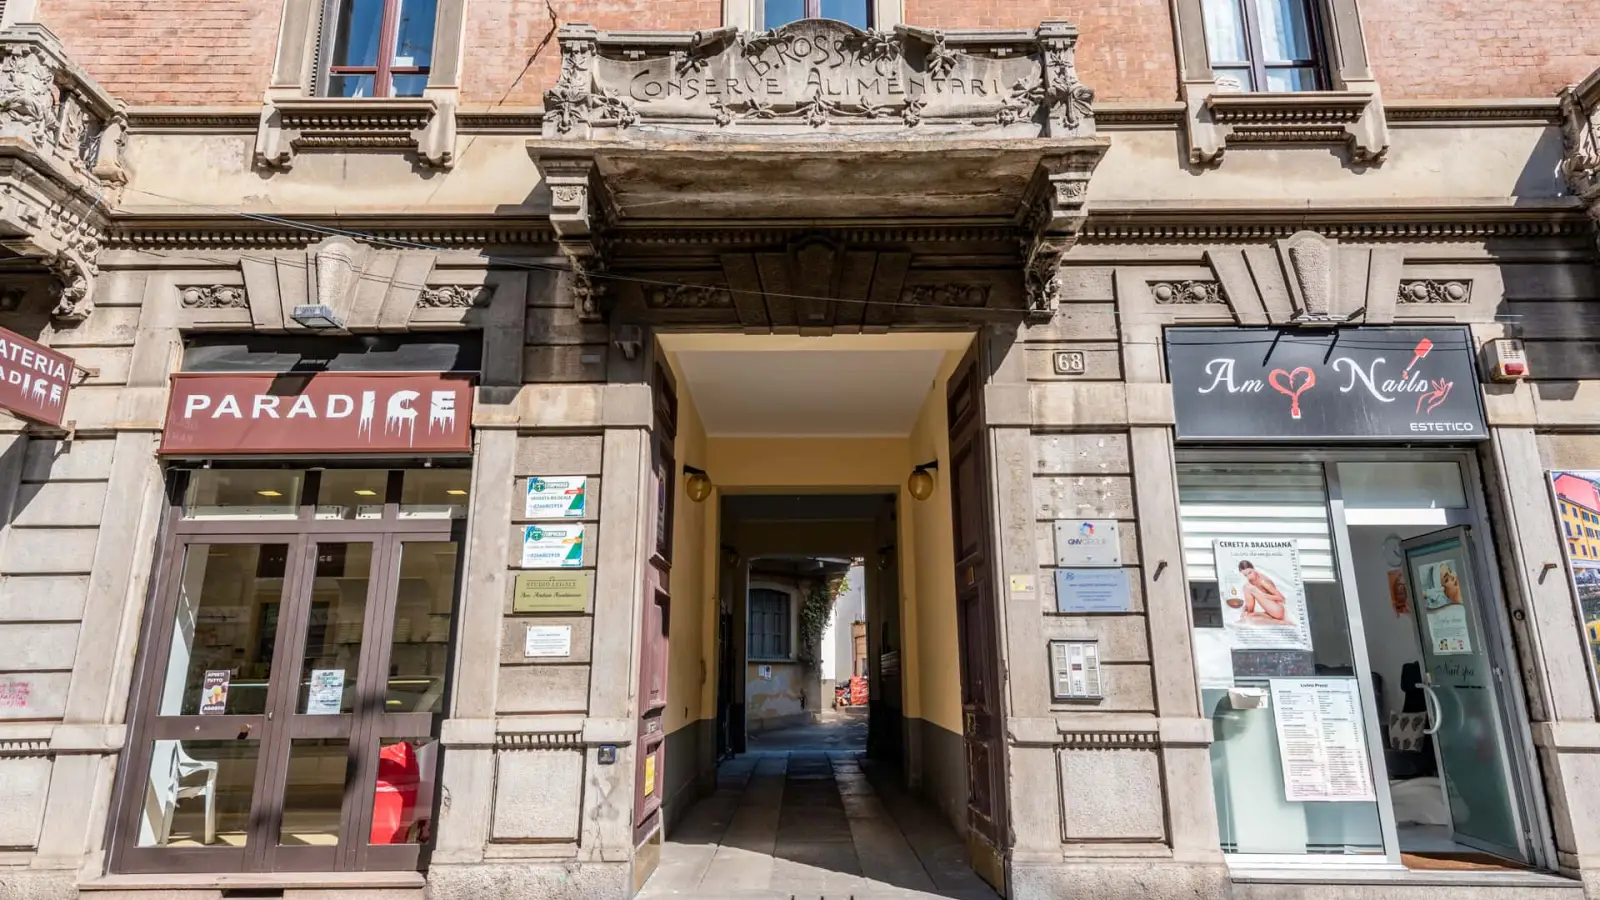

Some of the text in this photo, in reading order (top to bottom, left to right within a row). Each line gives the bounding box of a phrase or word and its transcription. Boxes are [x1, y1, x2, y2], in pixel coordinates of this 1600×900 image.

[804, 67, 999, 98] ALIMENTARI
[1058, 353, 1081, 371] 68
[1198, 356, 1430, 402] Am Nails
[184, 390, 457, 443] PARADICE
[1409, 422, 1474, 432] ESTETICO
[1219, 540, 1293, 548] CERETTA BRASILIANA
